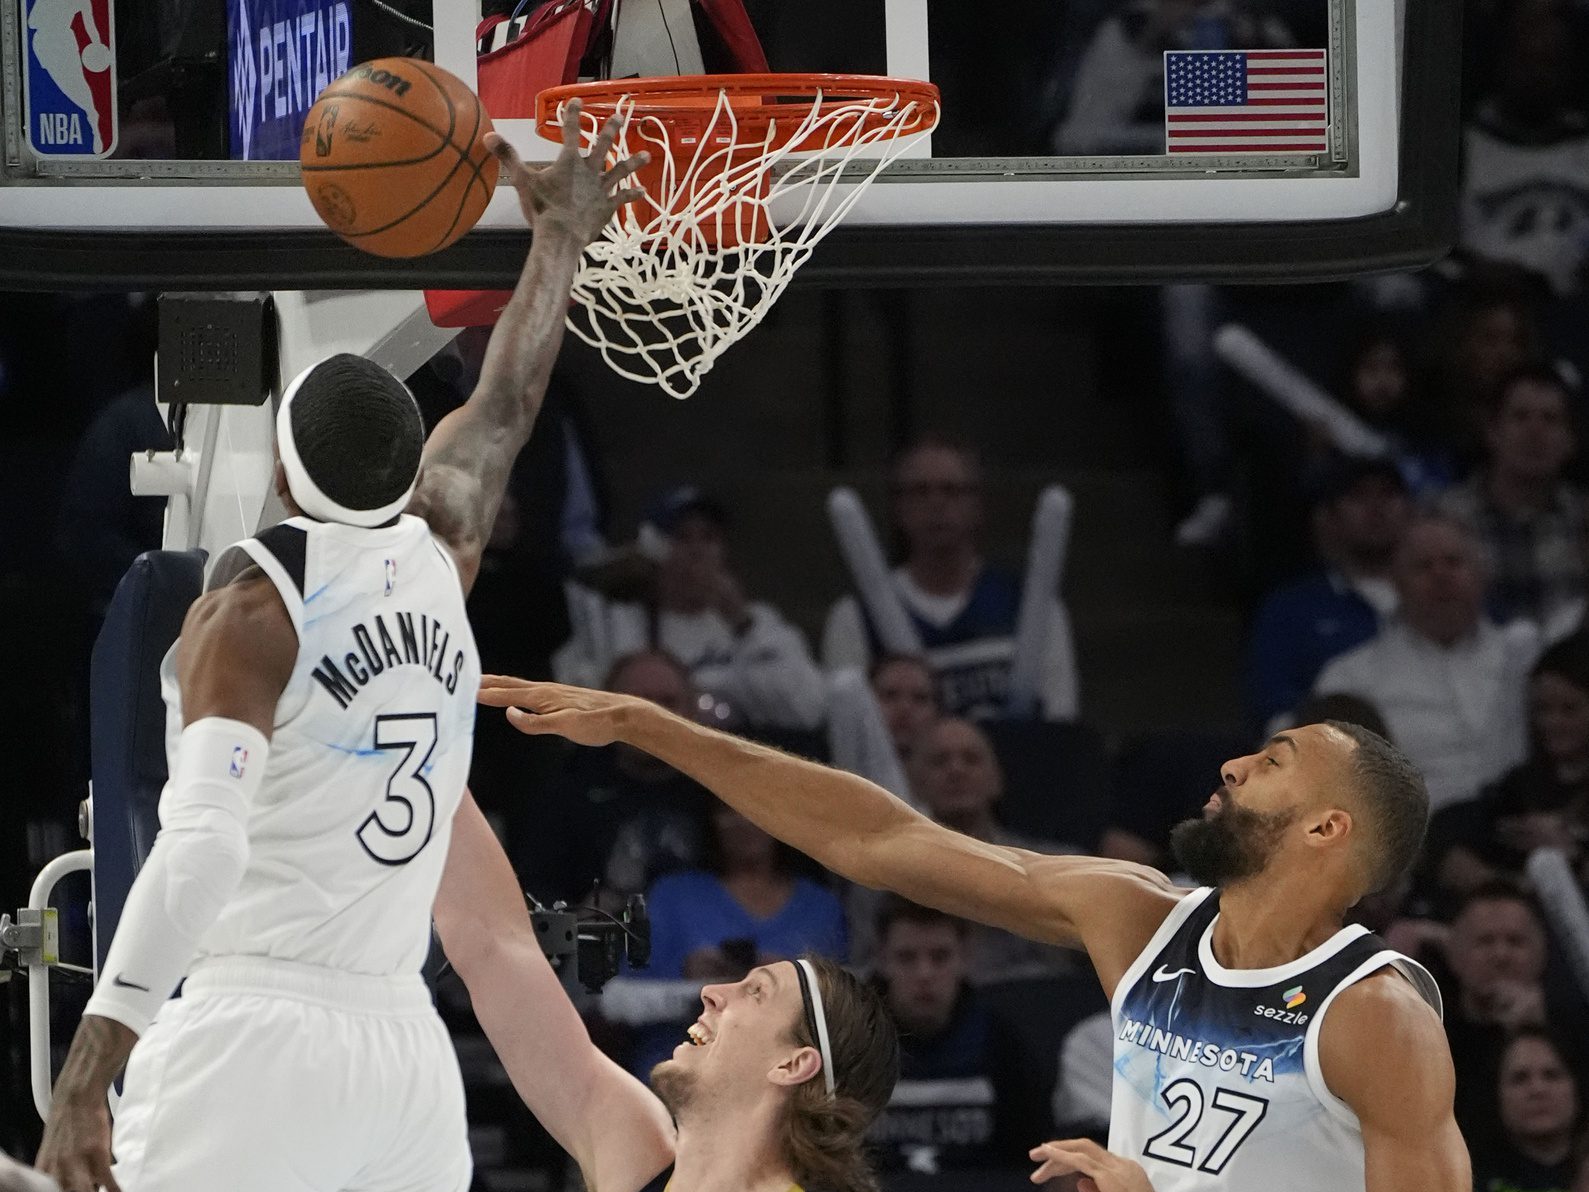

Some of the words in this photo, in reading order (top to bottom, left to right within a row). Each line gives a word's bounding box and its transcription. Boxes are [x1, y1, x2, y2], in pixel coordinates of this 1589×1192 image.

[259, 2, 349, 123] PENTAIR
[39, 112, 83, 145] NBA
[310, 611, 464, 711] McDANIELS
[354, 711, 438, 867] 3
[1118, 1019, 1275, 1083] MINNESOTA
[1253, 1004, 1309, 1026] sezzle
[1142, 1077, 1270, 1176] 27
